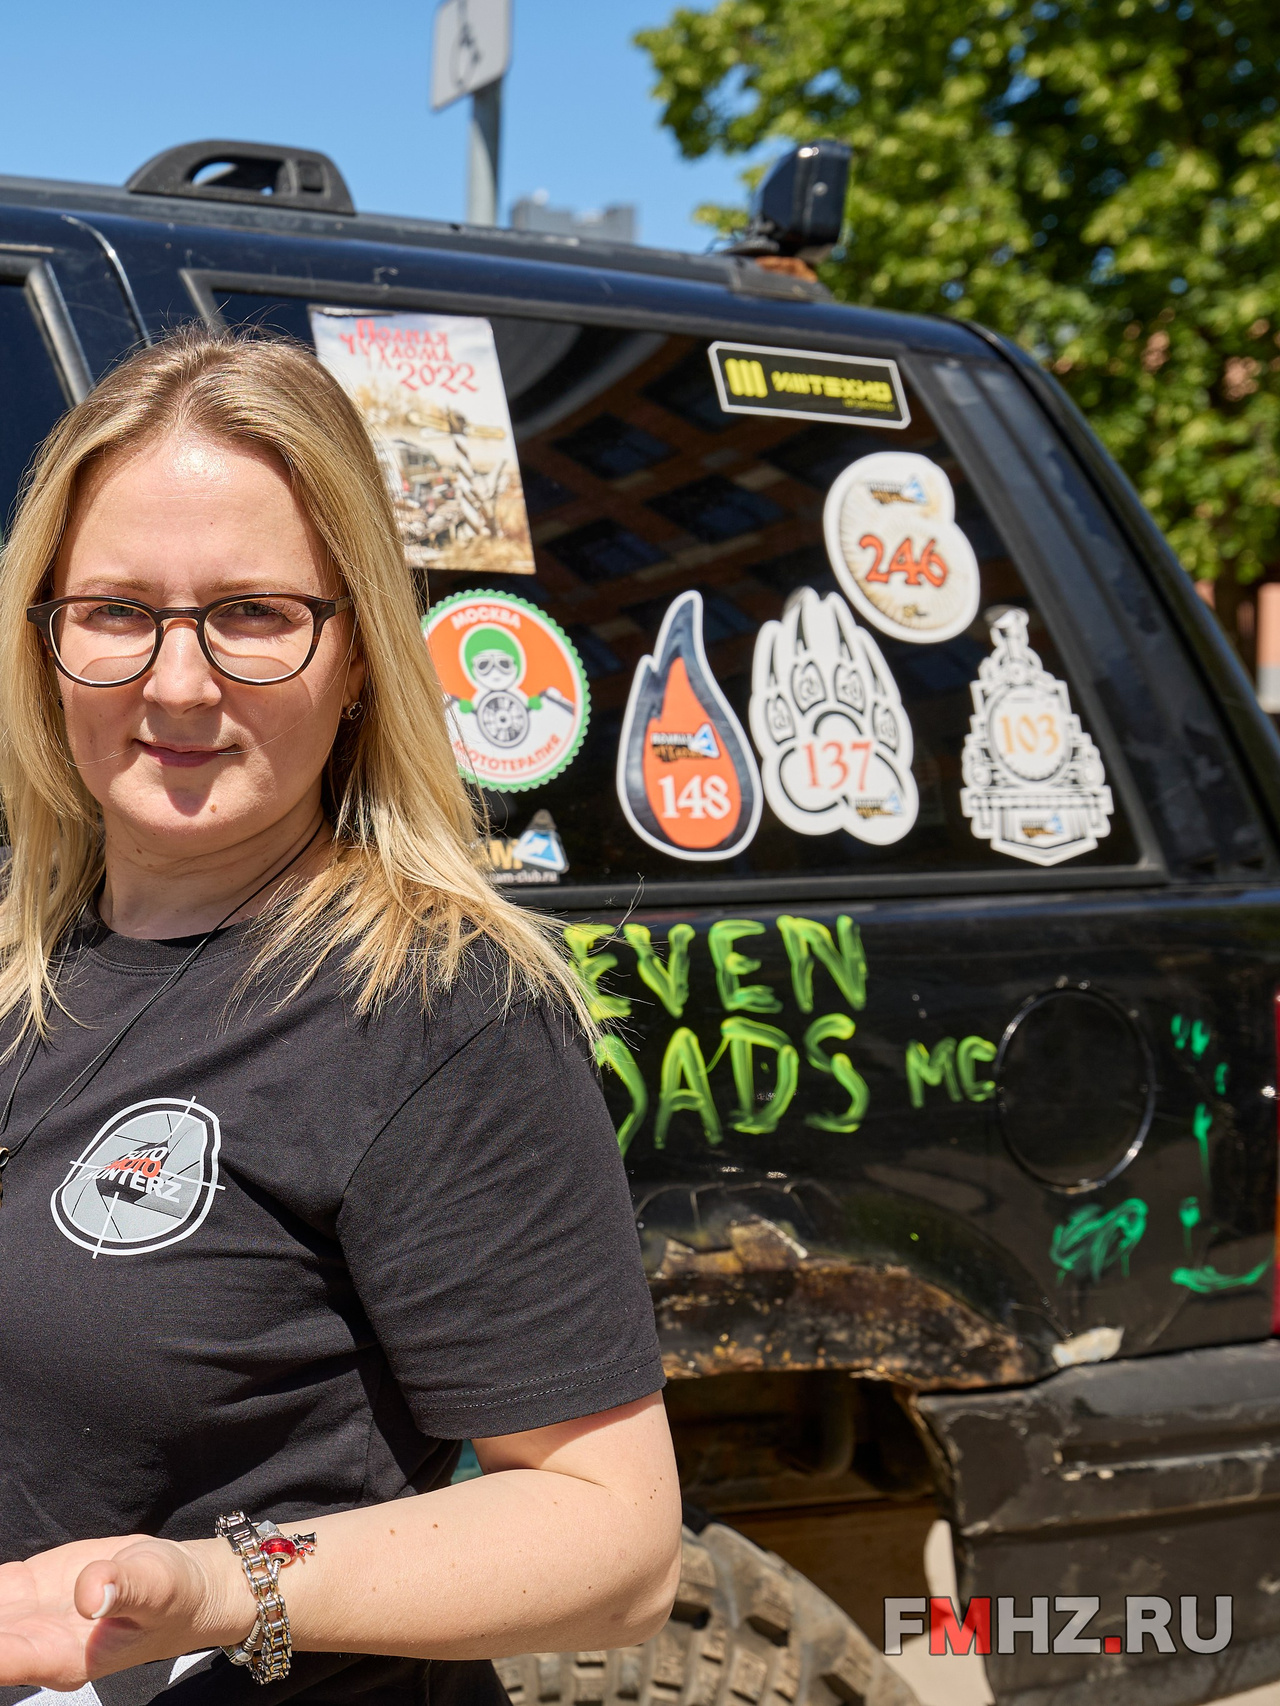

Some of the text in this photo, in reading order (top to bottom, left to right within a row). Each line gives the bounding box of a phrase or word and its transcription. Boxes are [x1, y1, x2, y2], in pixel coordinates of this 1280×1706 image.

[397, 361, 478, 394] 2022
[859, 534, 949, 588] 246
[450, 605, 522, 631] МОСКВА
[1001, 713, 1060, 756] 103
[803, 741, 873, 792] 137
[658, 775, 732, 819] 148
[80, 1165, 182, 1203] HUNTERZ
[104, 1157, 162, 1178] MOTO
